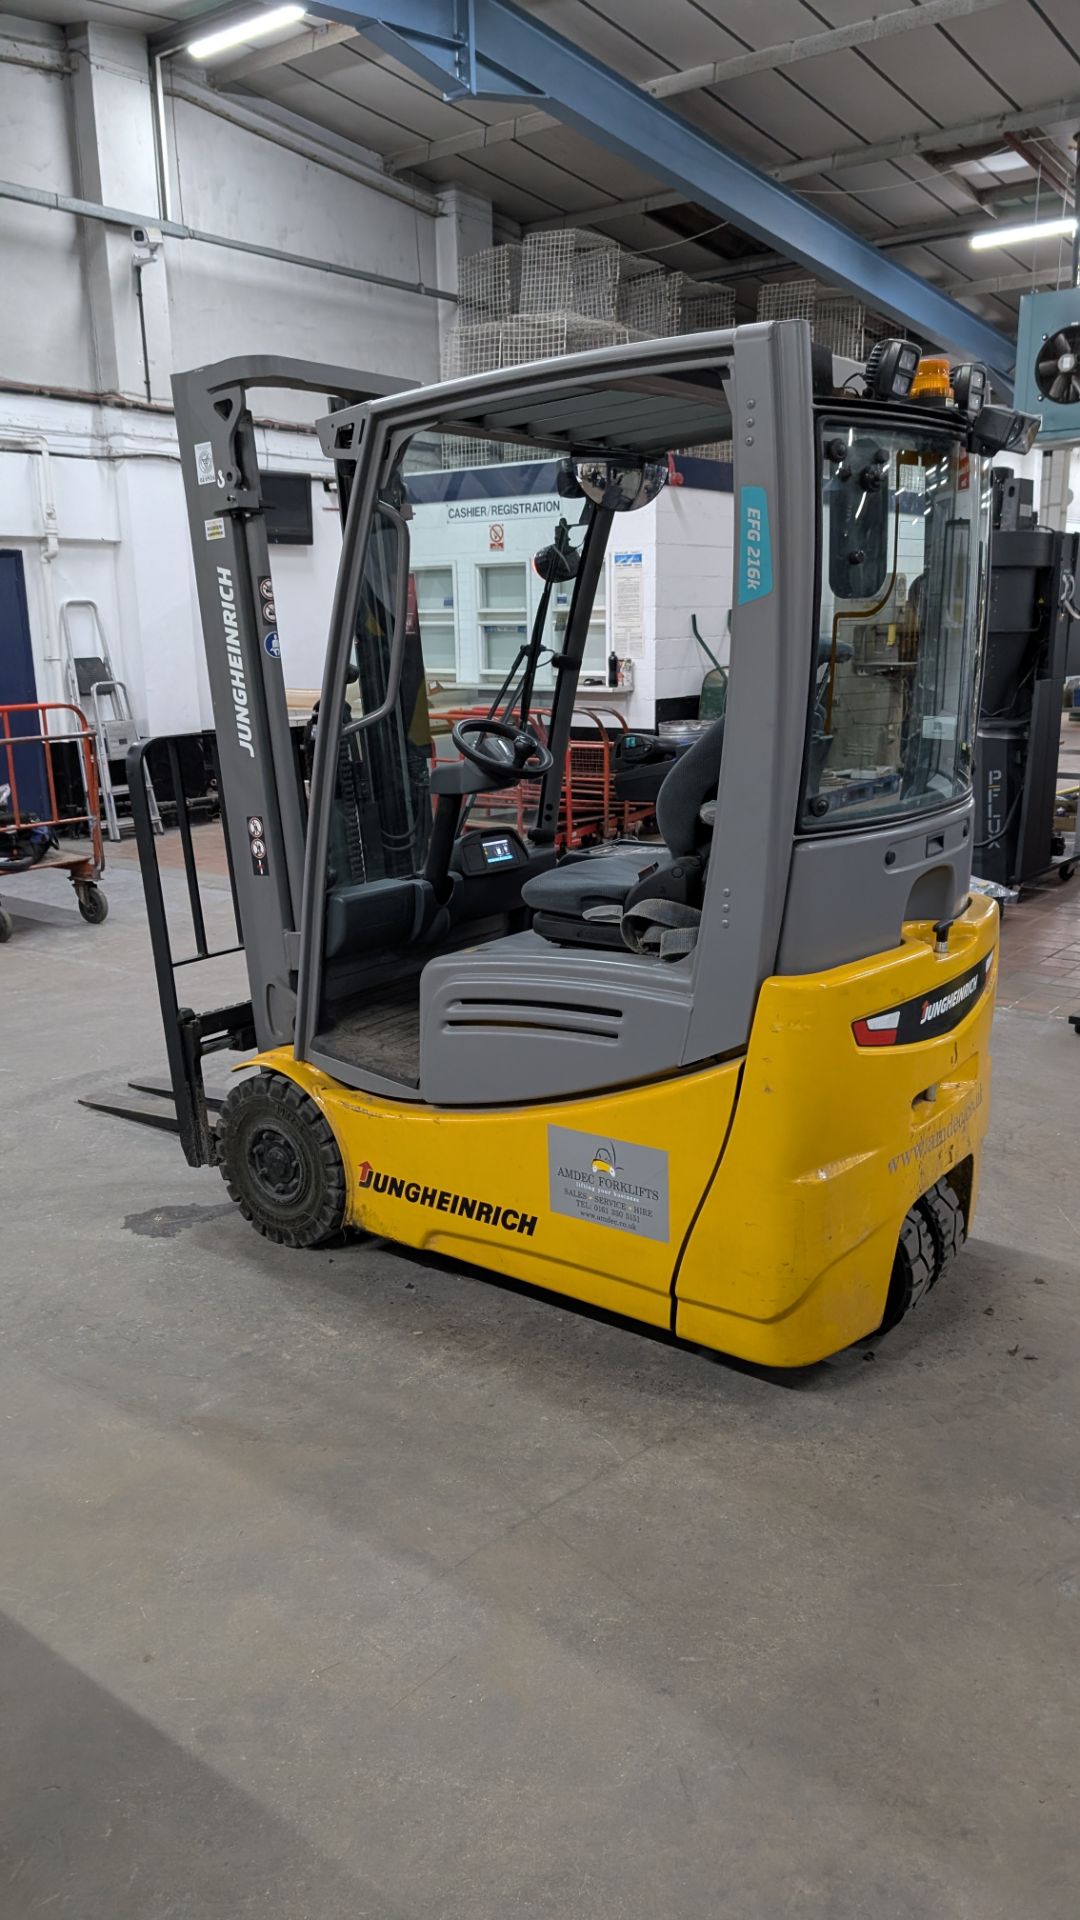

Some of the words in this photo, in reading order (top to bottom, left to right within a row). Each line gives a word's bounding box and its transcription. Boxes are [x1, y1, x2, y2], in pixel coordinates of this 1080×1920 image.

[448, 500, 560, 519] CASHIER/REGISTRATION
[747, 507, 761, 542] EFG
[747, 546, 761, 590] 216k
[216, 566, 255, 758] JUNGHEINRICH
[919, 973, 979, 1025] JUNGHEINRICH
[358, 1168, 539, 1237] JUNGHEINRICH
[557, 1167, 595, 1185] AMDEC
[598, 1176, 660, 1201] FORKLIFTS
[564, 1188, 588, 1200] SALES
[594, 1195, 627, 1211] SERVICE
[633, 1207, 654, 1218] HIRE
